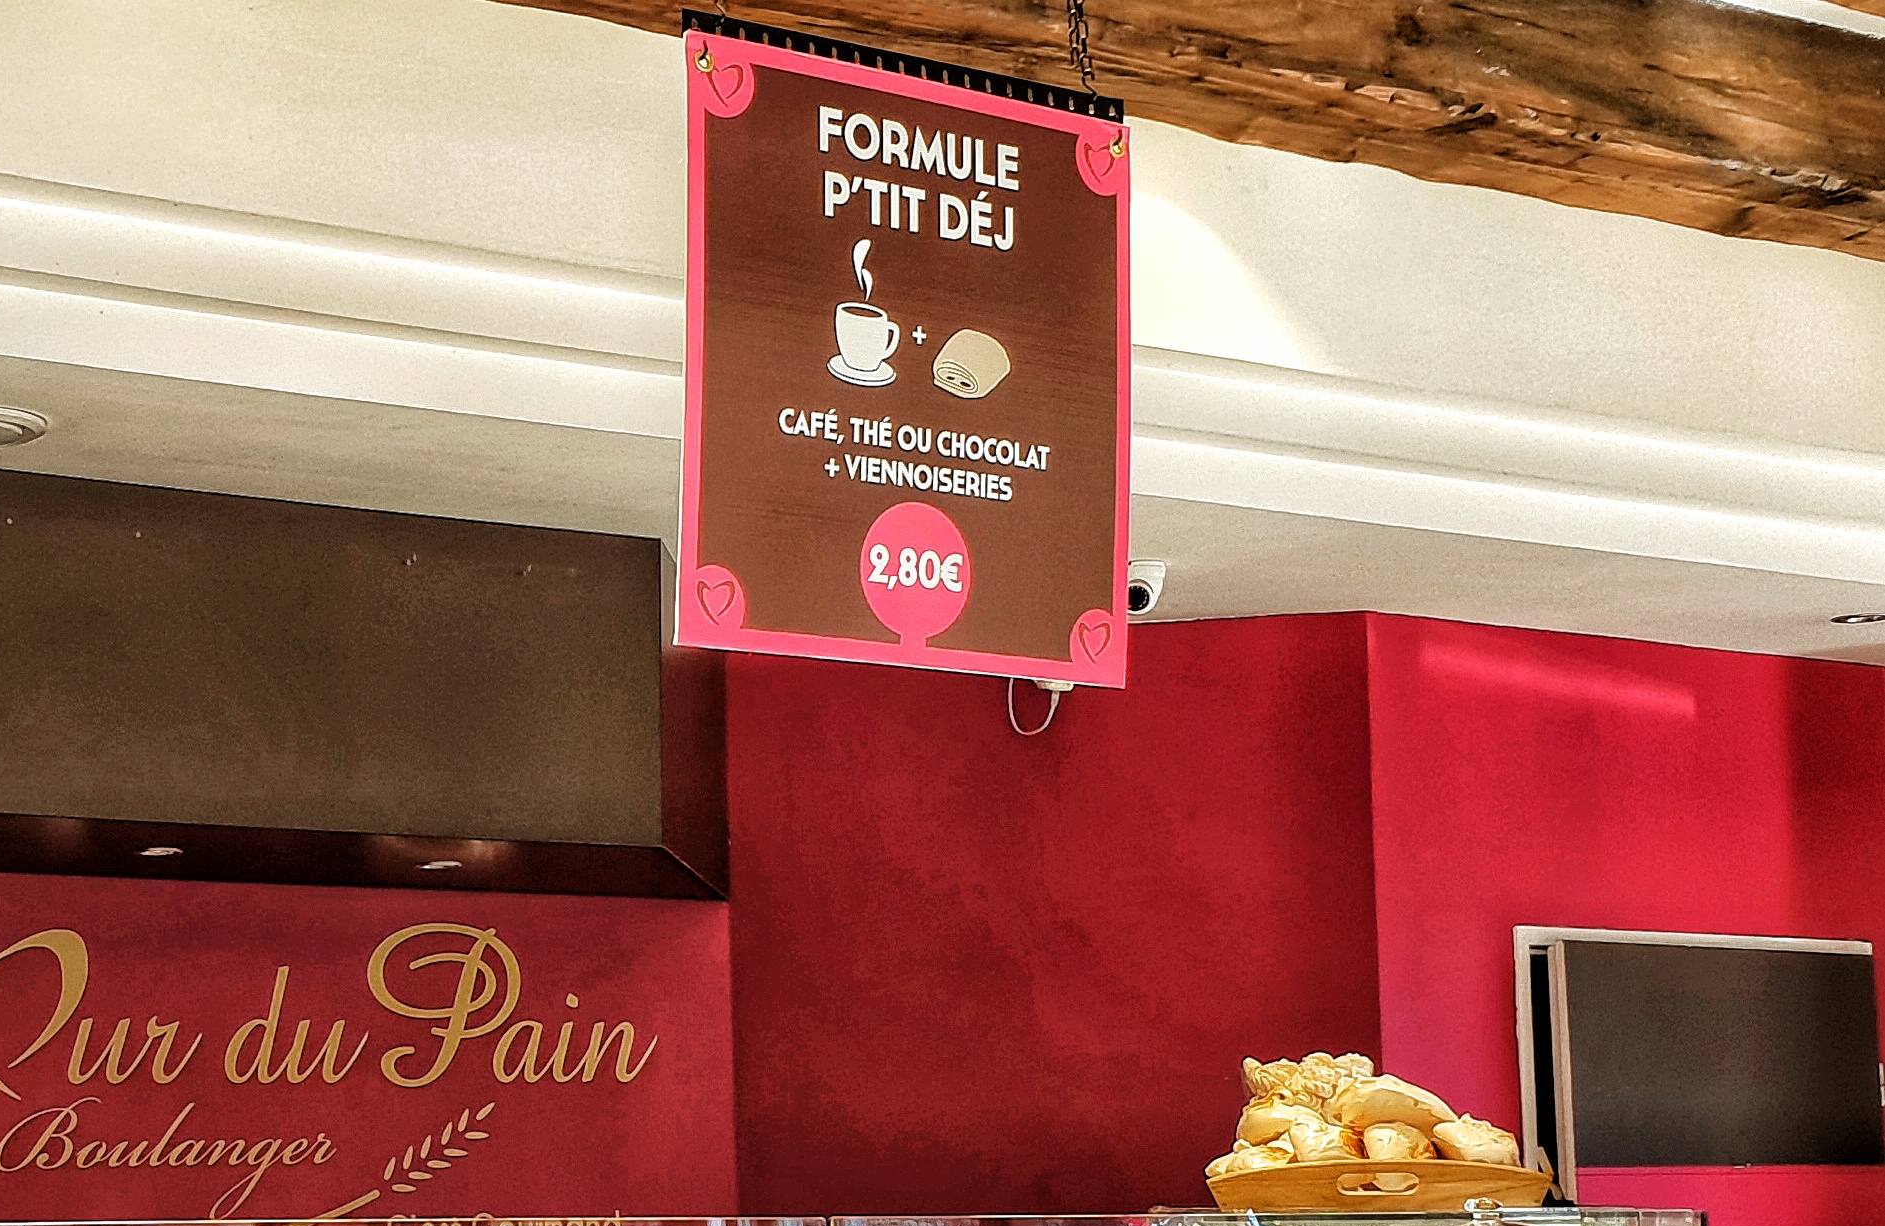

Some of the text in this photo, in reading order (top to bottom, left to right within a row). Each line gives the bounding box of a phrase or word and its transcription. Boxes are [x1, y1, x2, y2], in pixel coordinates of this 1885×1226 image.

[819, 105, 1020, 190] FORMULE
[823, 171, 1015, 251] P'TIT DÉJ
[778, 407, 1050, 470] CAFÉ, THÉ OU CHOCOLAT
[844, 456, 1013, 501] VIENNOISERIES
[867, 544, 962, 592] 2,80€
[224, 965, 370, 1085] du
[366, 922, 657, 1088] Pain
